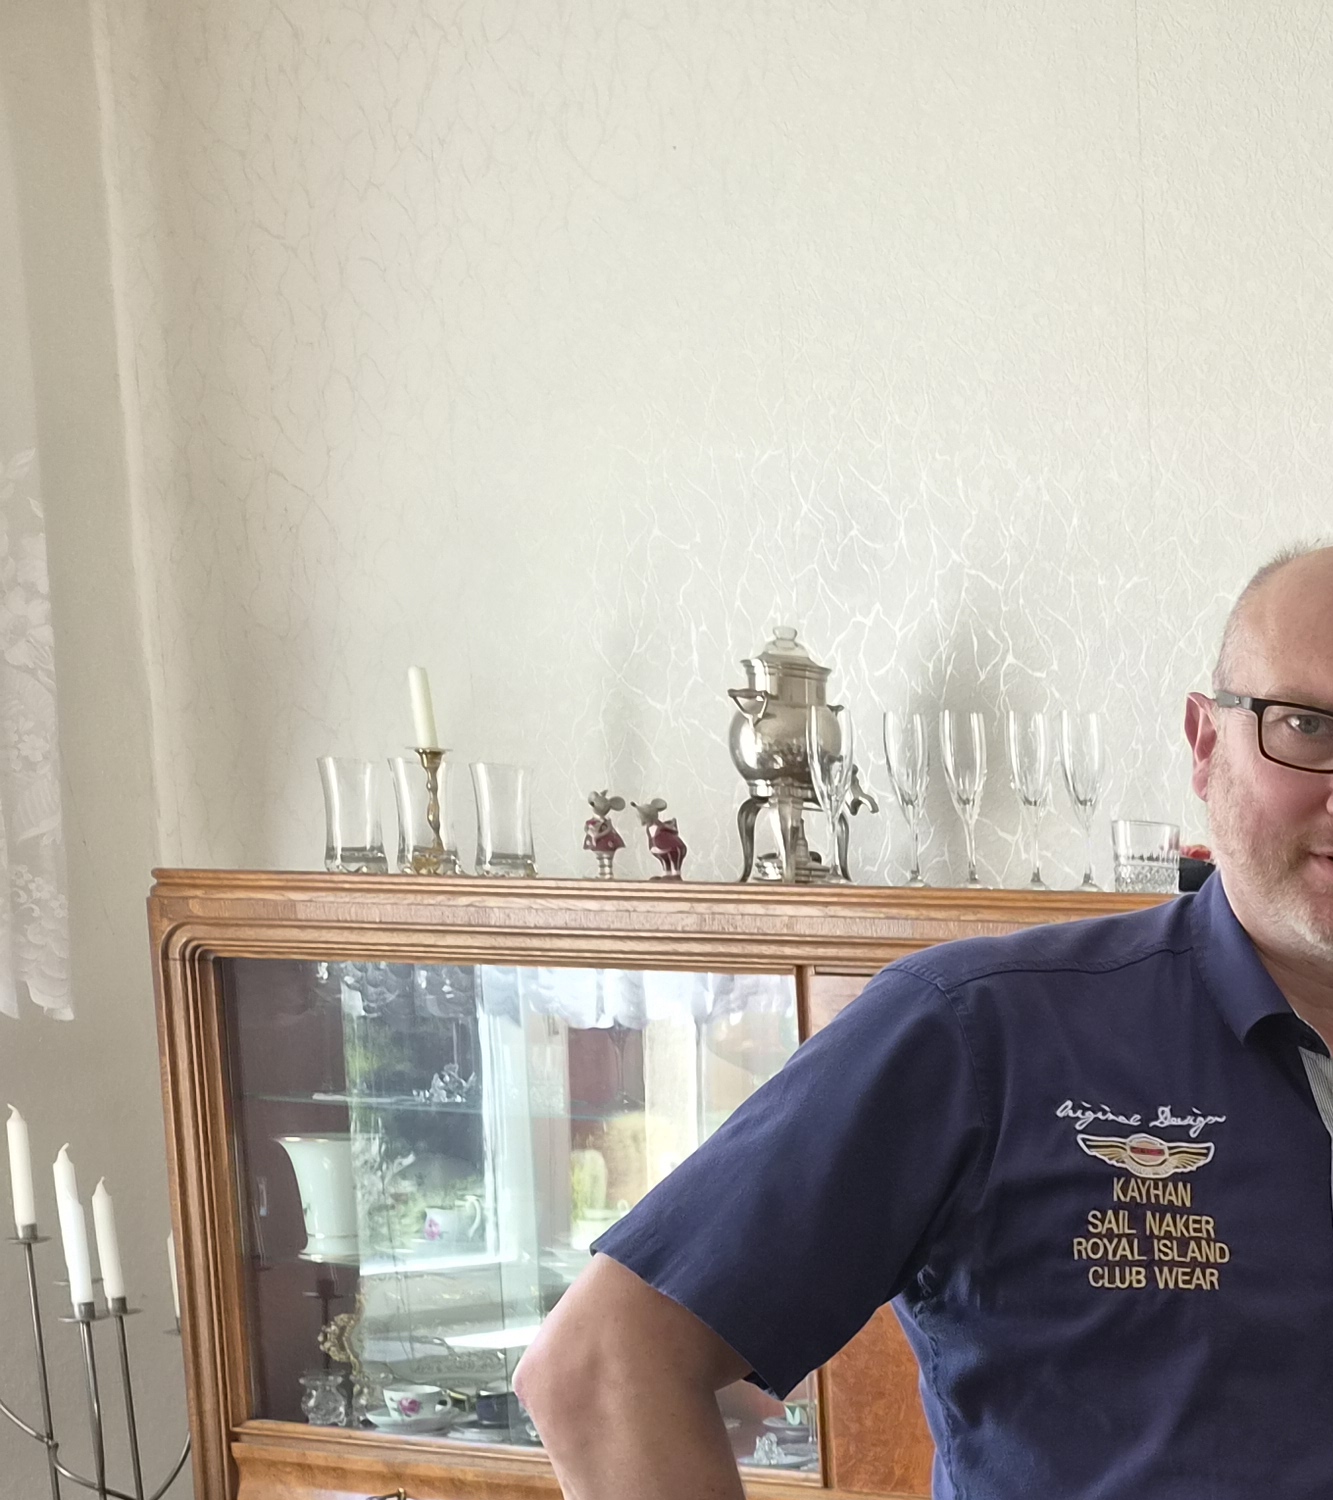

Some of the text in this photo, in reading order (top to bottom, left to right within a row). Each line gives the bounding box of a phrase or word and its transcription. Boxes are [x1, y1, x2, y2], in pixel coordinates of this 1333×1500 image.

[1113, 1177, 1192, 1207] KAYHAN
[1087, 1210, 1216, 1239] SAIL NAKER
[1073, 1237, 1231, 1264] ROYAL ISLAND
[1088, 1266, 1220, 1290] CLUB WEAR
